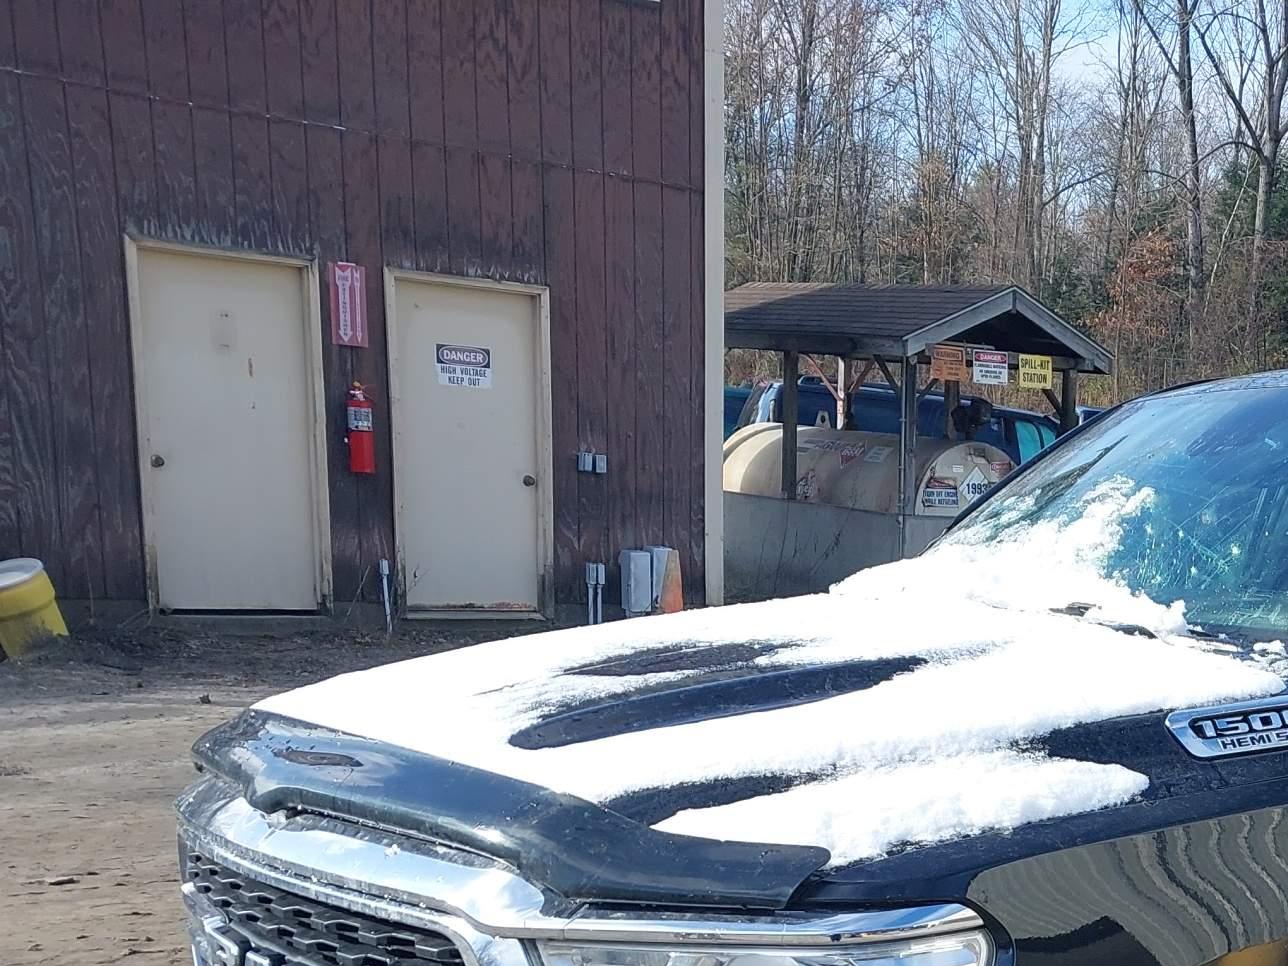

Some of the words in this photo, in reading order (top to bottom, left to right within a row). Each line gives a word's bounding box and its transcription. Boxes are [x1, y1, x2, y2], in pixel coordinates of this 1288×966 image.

[443, 349, 484, 363] DANGER
[980, 353, 1002, 361] DANGER
[1020, 358, 1050, 370] SPILL-KIT
[440, 365, 457, 375] HIGH
[460, 367, 487, 378] VOLTAGE
[448, 376, 465, 385] KEEP
[468, 377, 480, 387] OUT
[1023, 372, 1048, 384] STATION
[1221, 734, 1272, 749] HEMI
